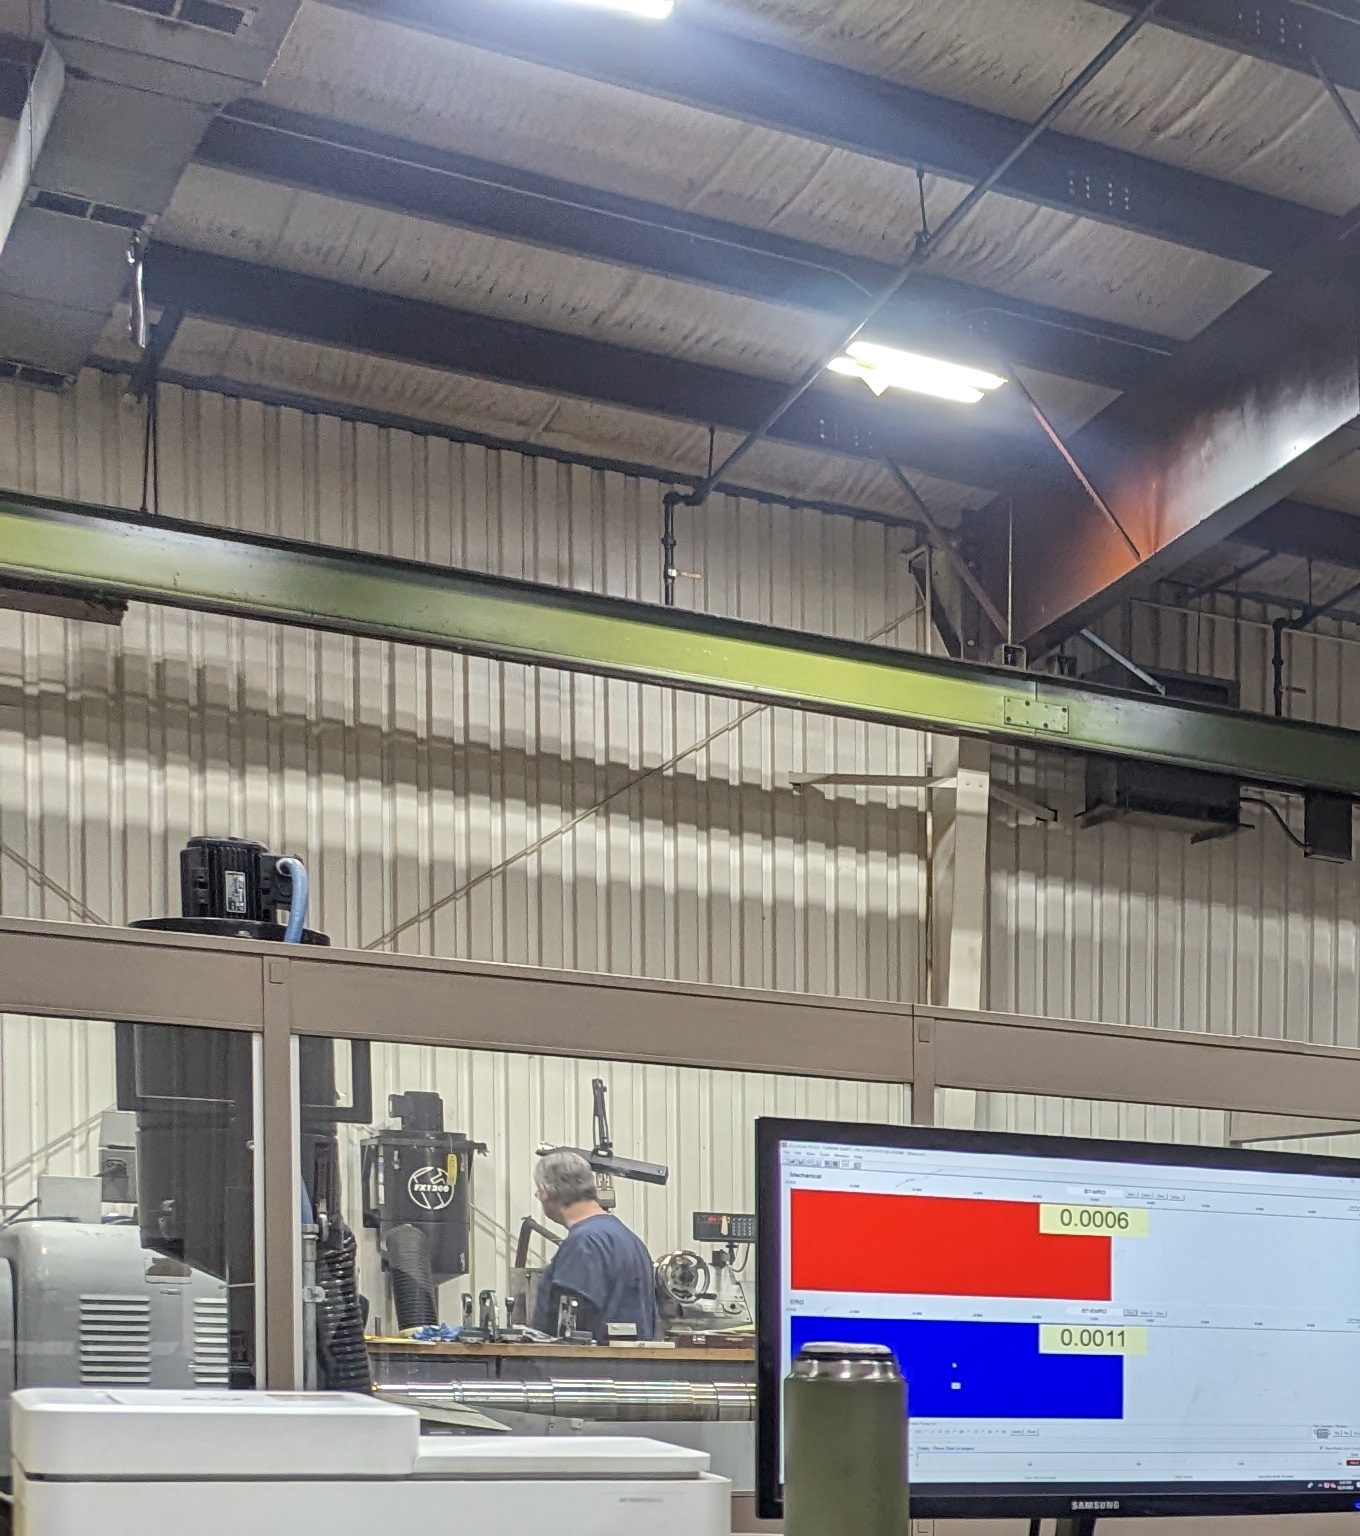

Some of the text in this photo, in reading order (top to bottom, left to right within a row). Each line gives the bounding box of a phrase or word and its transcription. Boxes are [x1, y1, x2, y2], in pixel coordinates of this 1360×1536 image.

[1060, 1208, 1129, 1229] 0.0006
[1060, 1328, 1125, 1347] 0.0011
[1071, 1501, 1120, 1511] SAMSUNG
